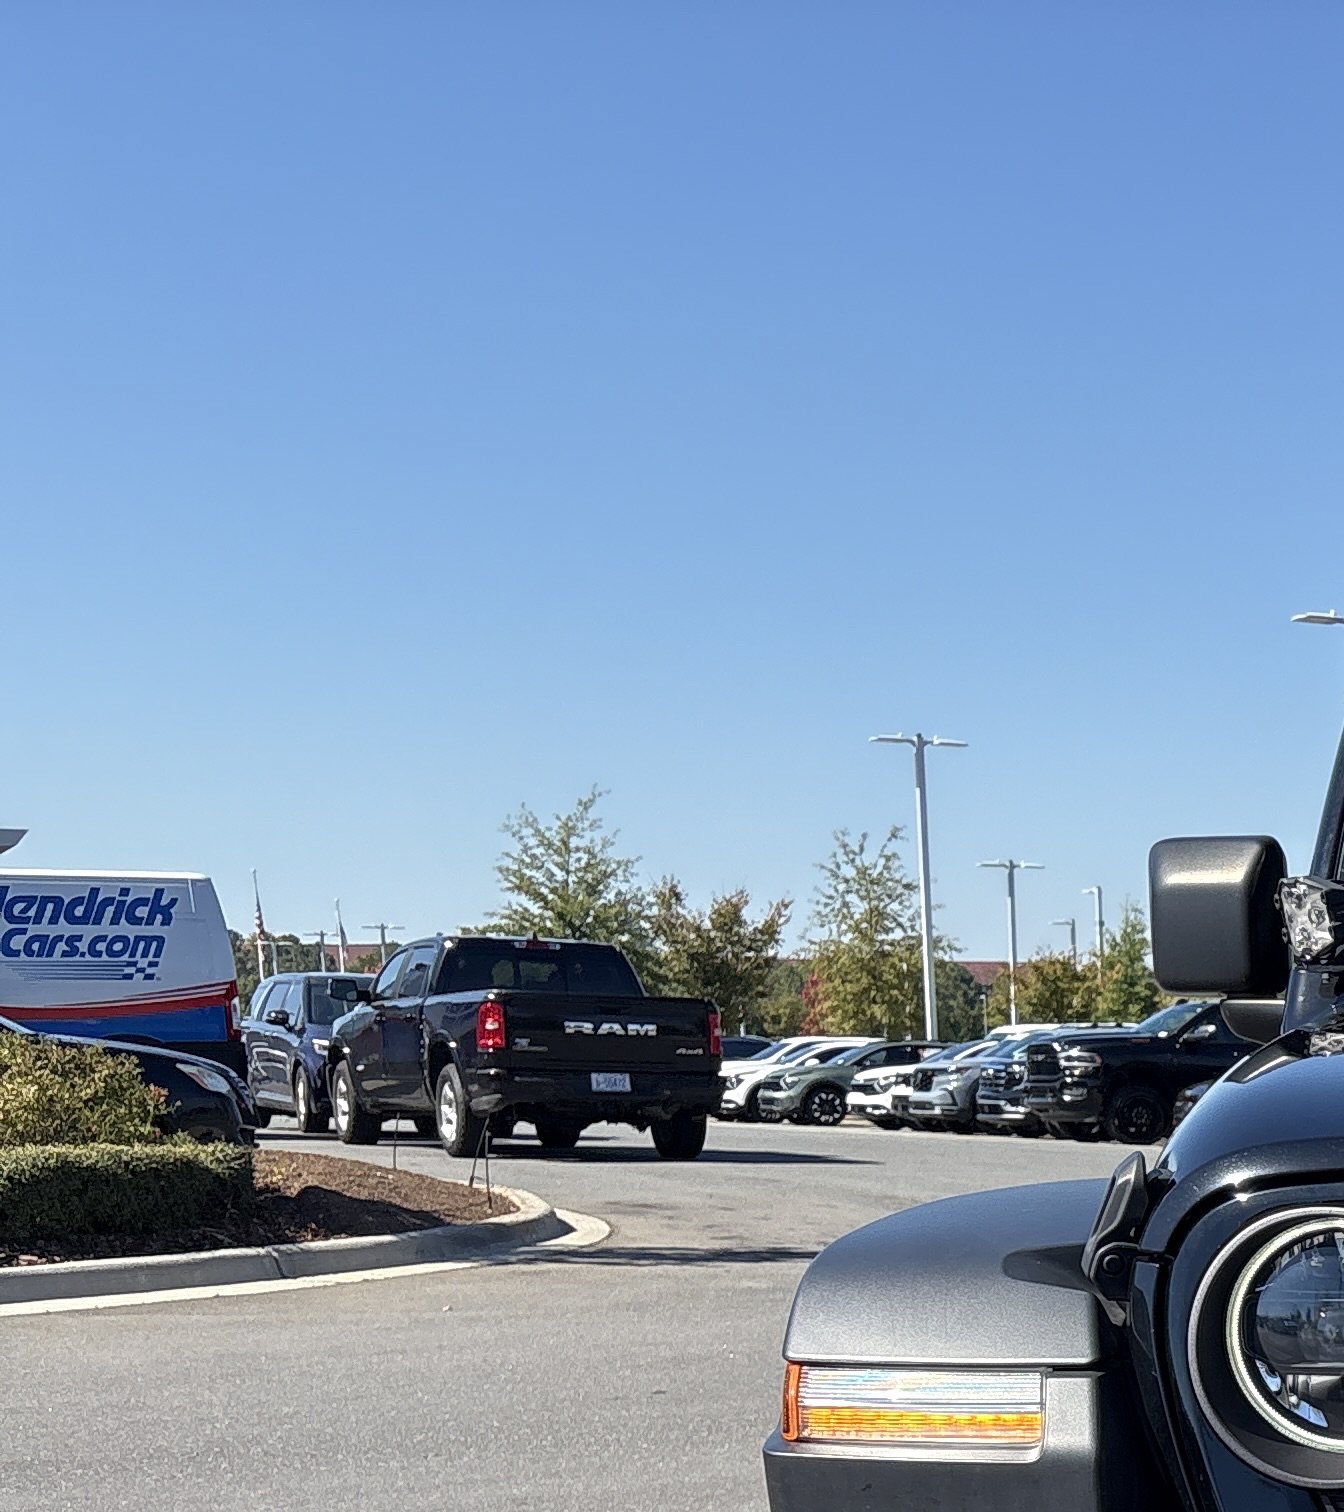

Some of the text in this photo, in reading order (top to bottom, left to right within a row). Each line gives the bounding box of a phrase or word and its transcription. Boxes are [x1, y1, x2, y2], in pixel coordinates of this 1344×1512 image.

[0, 885, 179, 926] endrick
[1, 927, 166, 958] Cars.com
[563, 1020, 657, 1036] RAM
